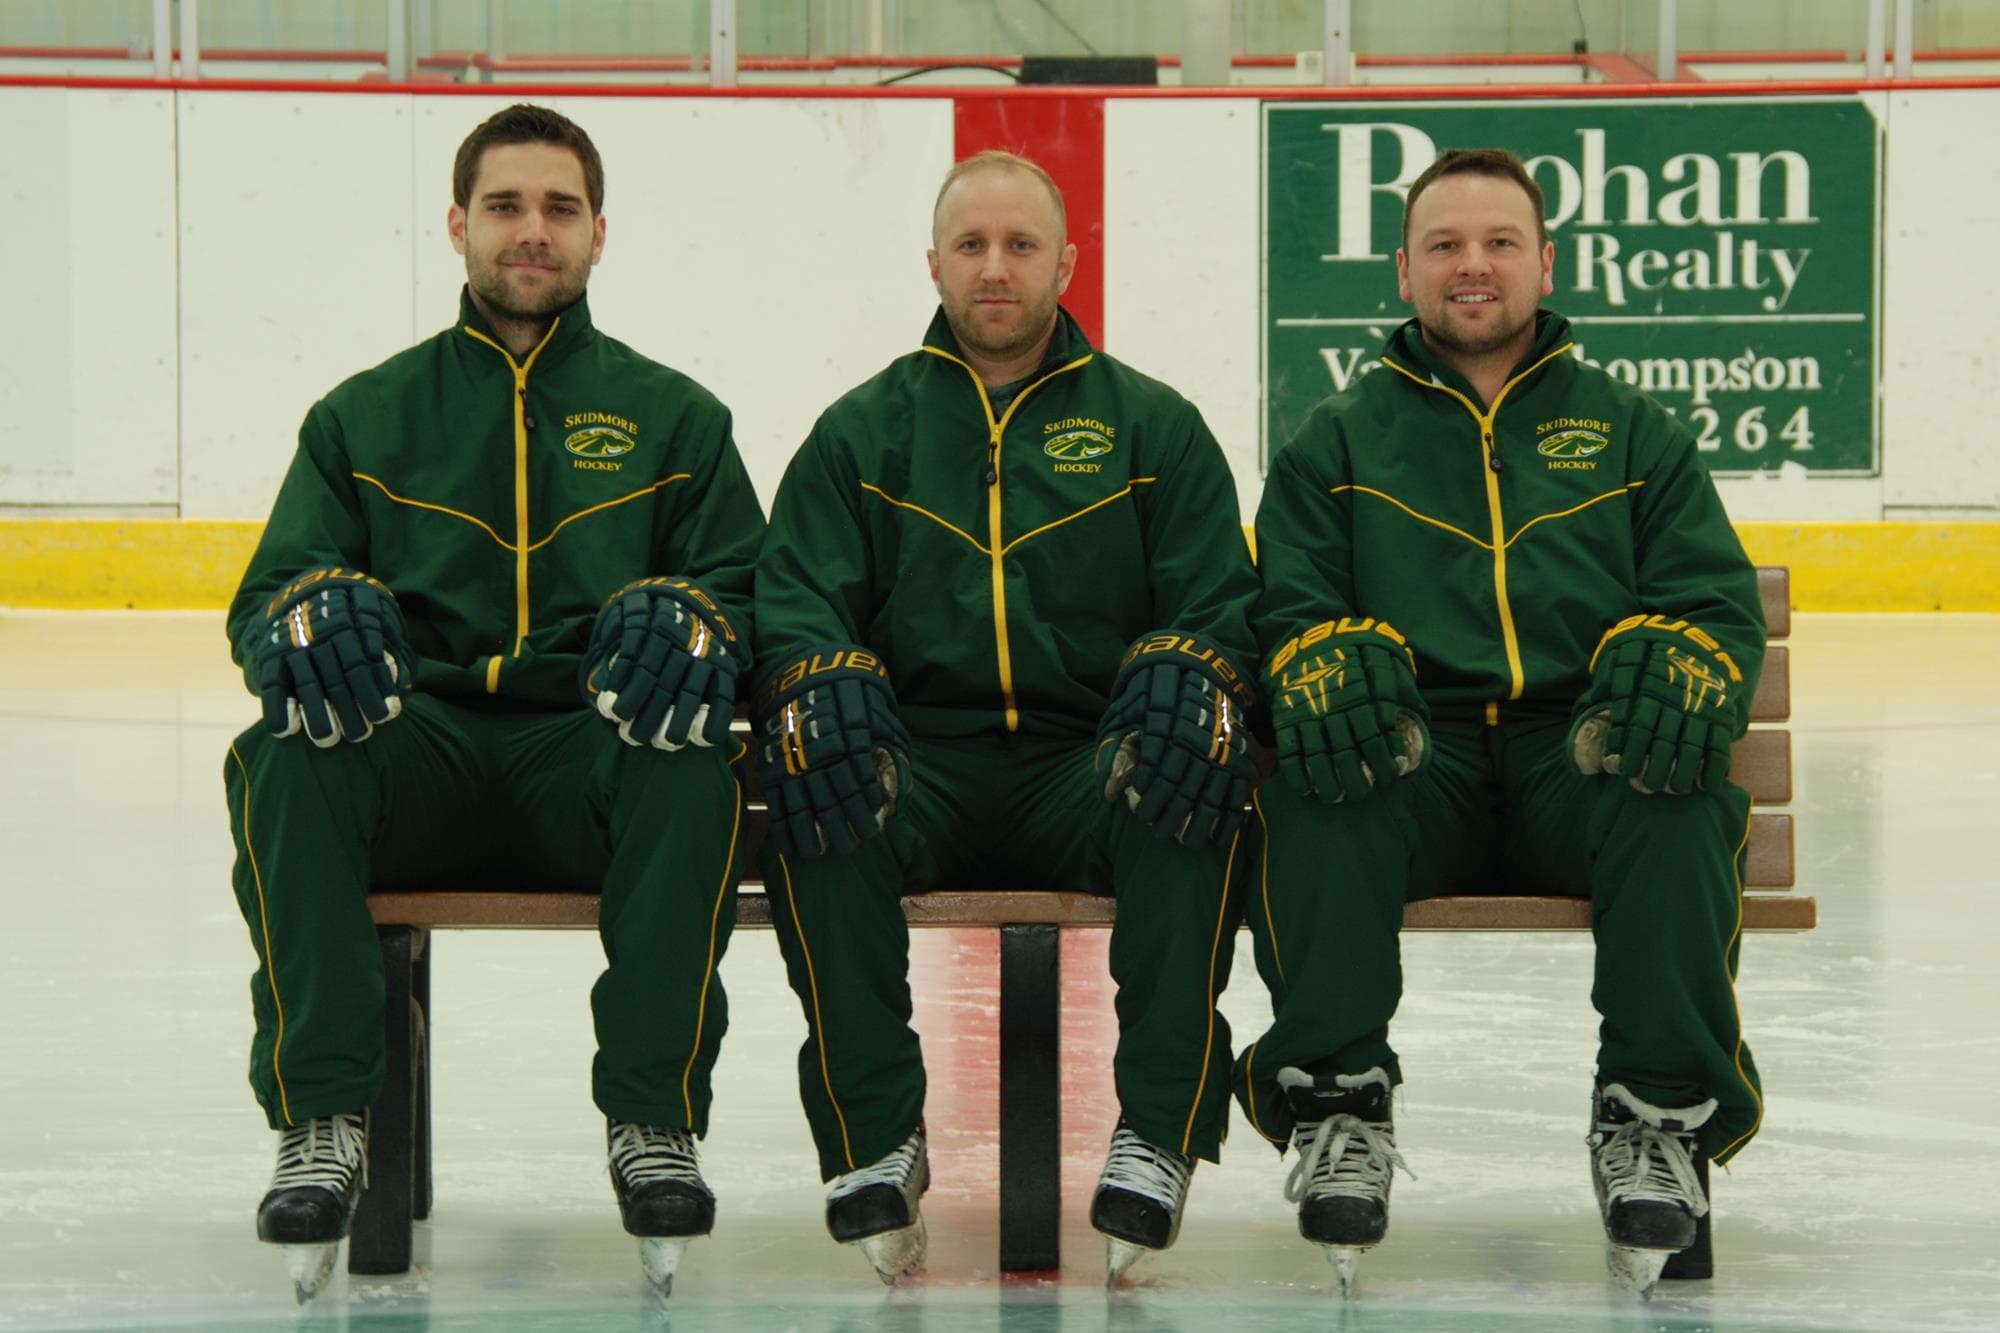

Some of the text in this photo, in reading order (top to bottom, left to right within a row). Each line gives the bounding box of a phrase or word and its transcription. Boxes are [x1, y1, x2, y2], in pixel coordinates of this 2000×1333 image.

[1320, 122, 1819, 261] Rohan
[1571, 231, 1812, 312] Realty
[564, 412, 639, 435] SKIDMORE
[1043, 417, 1116, 438] SKIDMORE
[1536, 418, 1612, 435] SKIDMORE
[1664, 405, 1815, 452] 264
[573, 459, 622, 472] HOCKEY
[1054, 463, 1102, 474] HOCKEY
[1548, 460, 1598, 471] HOCKEY
